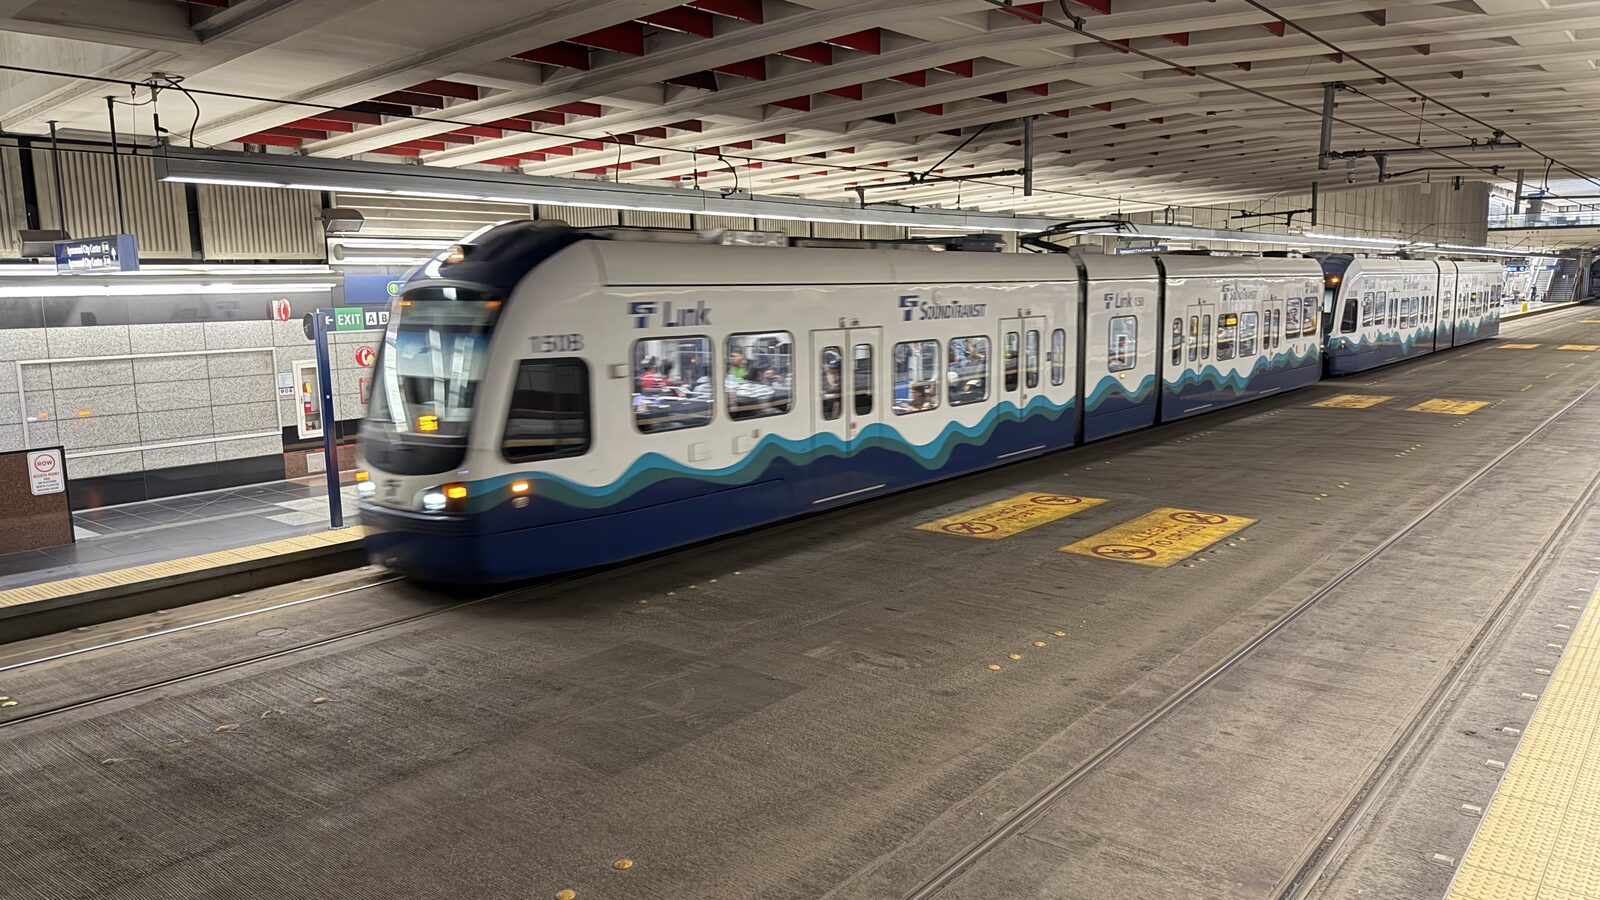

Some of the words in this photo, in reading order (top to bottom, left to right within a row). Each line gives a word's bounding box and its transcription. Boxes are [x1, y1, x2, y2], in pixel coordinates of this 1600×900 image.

[337, 313, 361, 326] EXIT
[367, 314, 375, 323] A
[381, 314, 388, 323] B
[662, 300, 713, 328] Link
